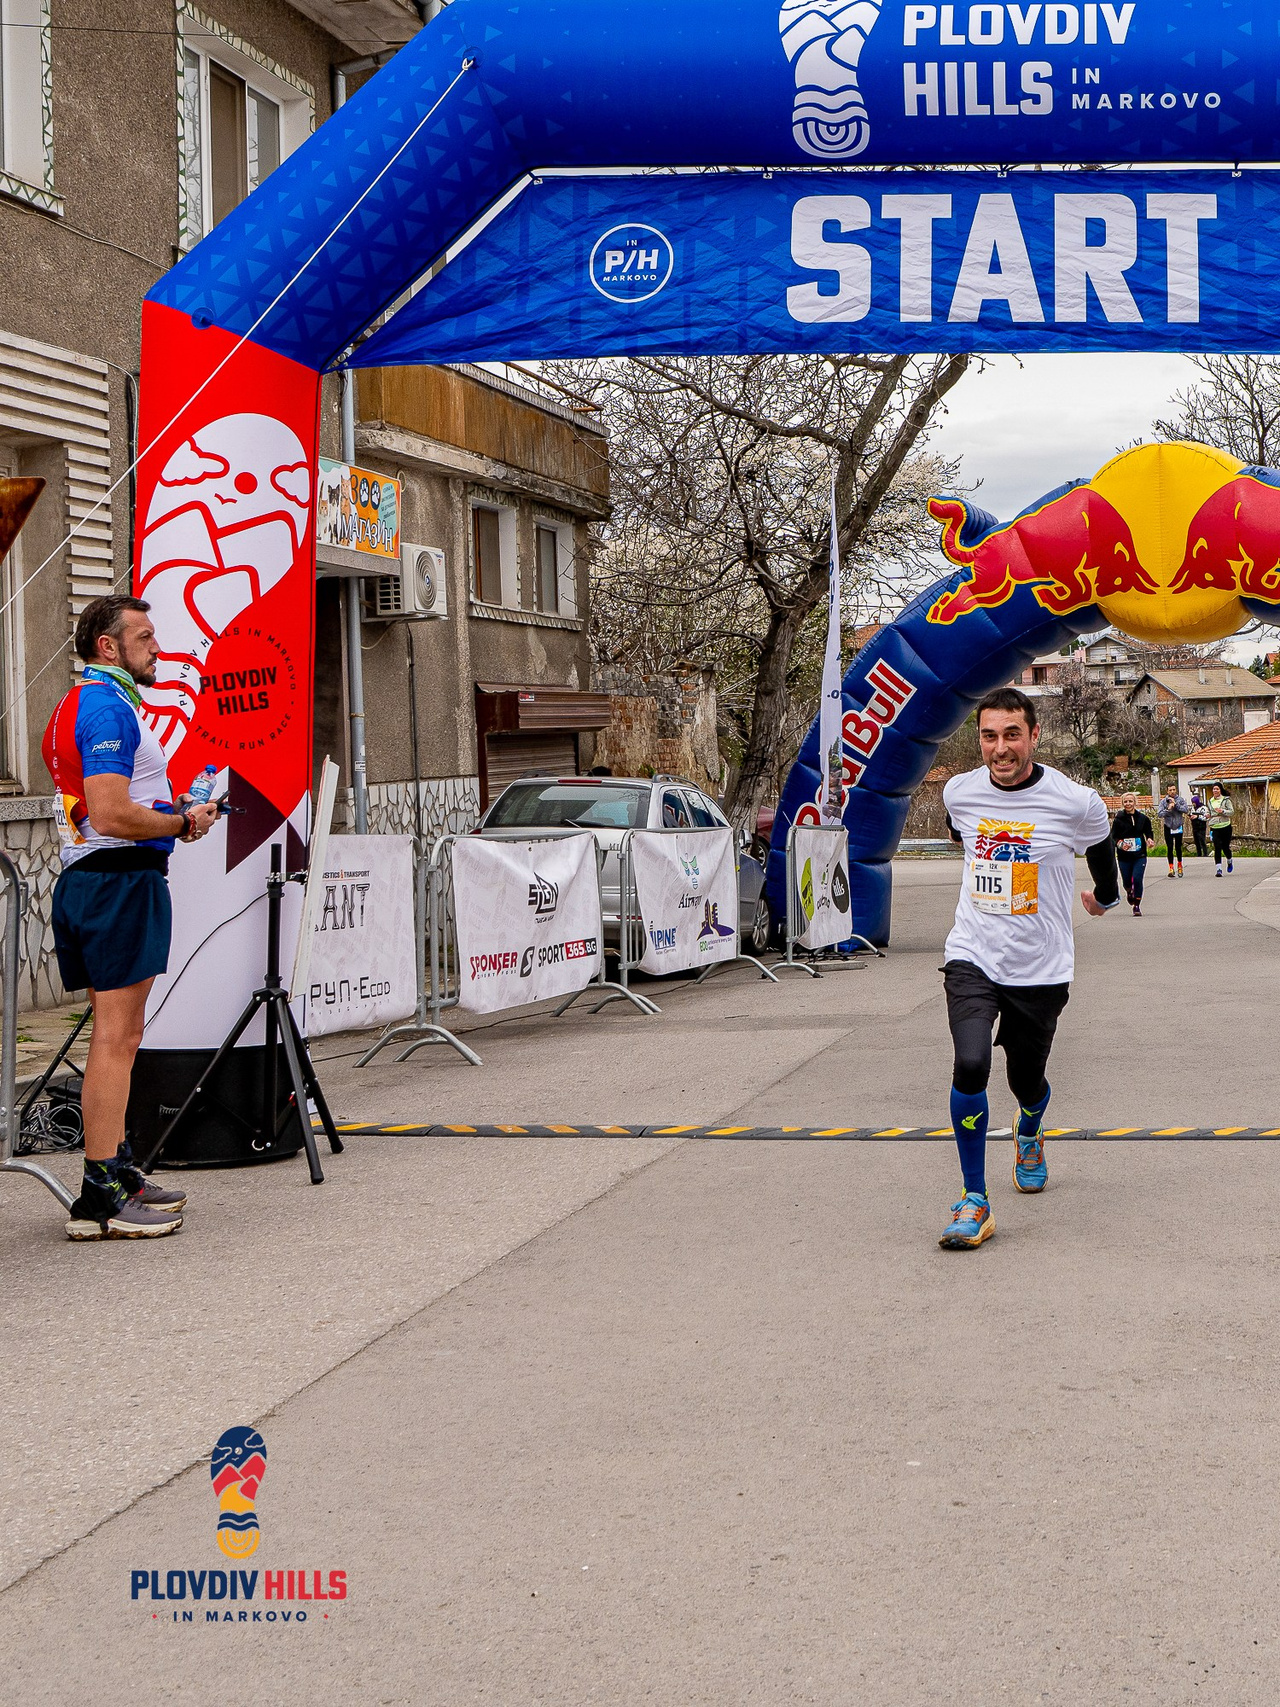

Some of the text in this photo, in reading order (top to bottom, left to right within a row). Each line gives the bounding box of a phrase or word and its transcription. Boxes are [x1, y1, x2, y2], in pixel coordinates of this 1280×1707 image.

[903, 3, 1136, 46] PLOVDIV
[904, 61, 1053, 116] HILLS
[1071, 68, 1100, 84] IN
[1071, 92, 1222, 110] MARKOVO
[604, 249, 659, 273] P/H
[786, 193, 1217, 324] START
[603, 274, 657, 282] MARKOVO
[340, 512, 394, 553] МАГАЗИН
[177, 627, 296, 707] PLOVDIV HILLS IN MARKOVO
[199, 666, 278, 695] PLOVDIV
[217, 691, 270, 716] HILLS
[841, 657, 918, 759] Bull
[195, 713, 291, 750] TRAIL RUN RACE
[975, 875, 1003, 894] 1115
[469, 951, 518, 981] SPONSER
